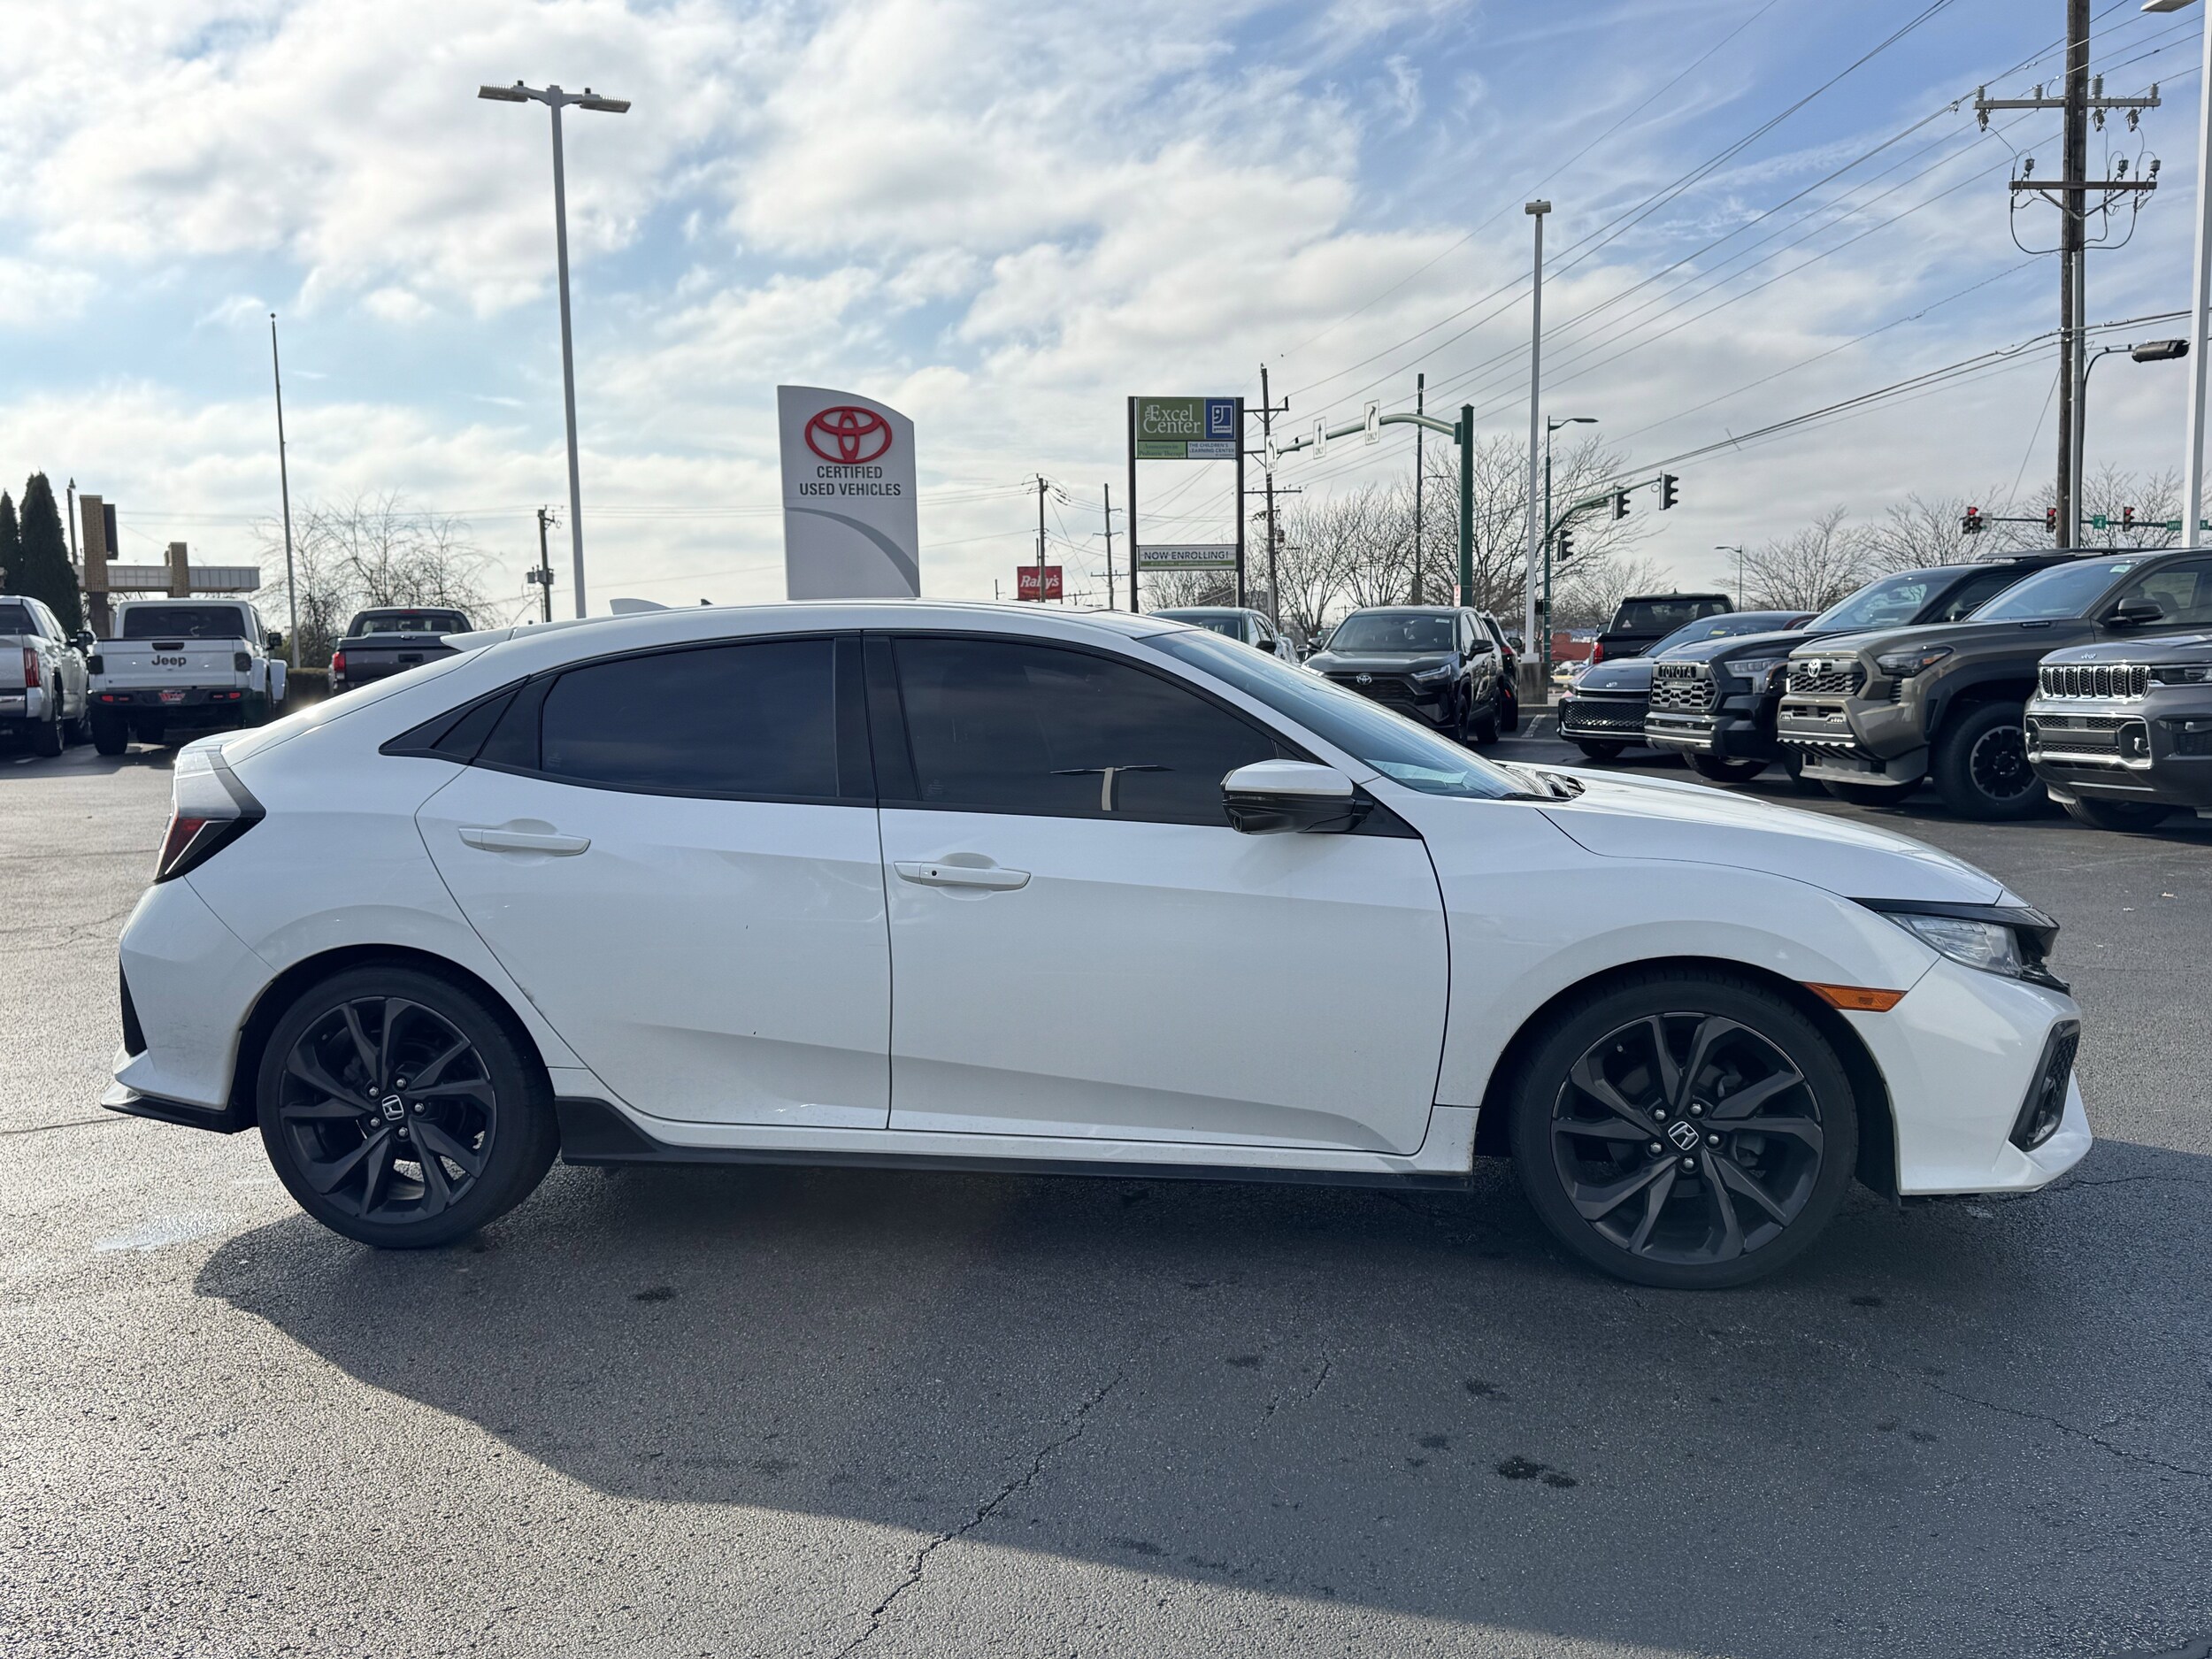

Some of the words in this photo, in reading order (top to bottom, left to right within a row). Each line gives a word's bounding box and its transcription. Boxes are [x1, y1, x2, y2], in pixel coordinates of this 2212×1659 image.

[1148, 404, 1194, 421] Excel
[1143, 417, 1201, 434] Center
[817, 465, 883, 479] CERTIFIED
[800, 483, 835, 495] USED
[839, 483, 902, 495] VEHICLES
[1020, 575, 1060, 589] Raly's
[151, 655, 187, 667] Jeep
[1661, 665, 1692, 678] TOYOTA
